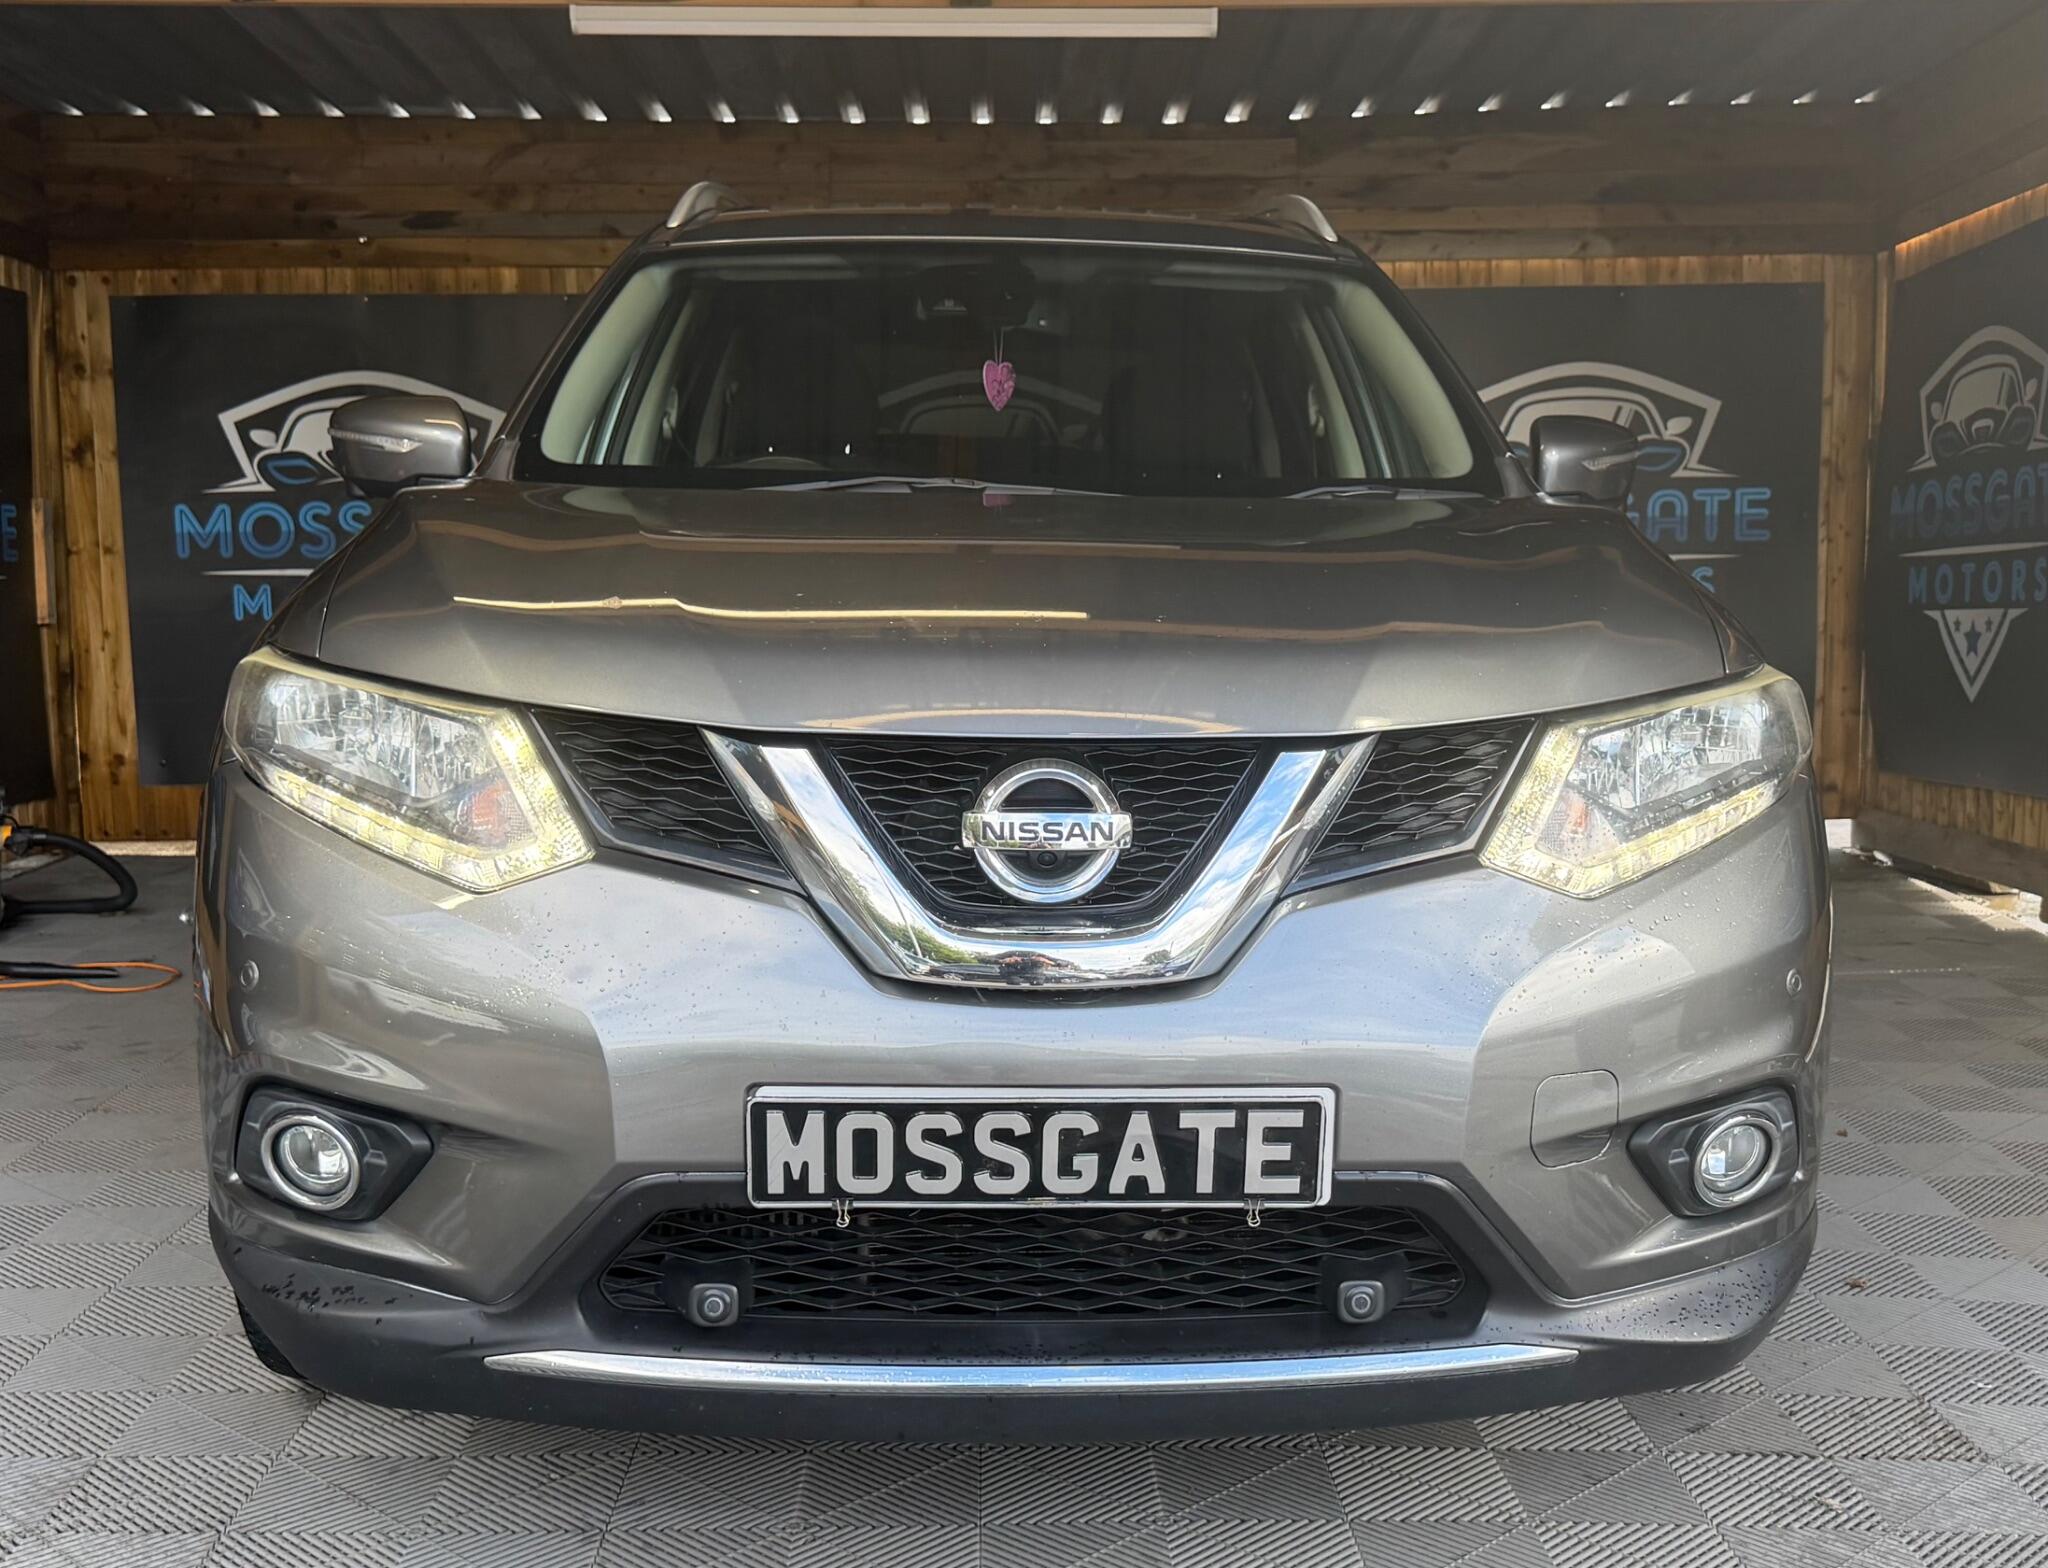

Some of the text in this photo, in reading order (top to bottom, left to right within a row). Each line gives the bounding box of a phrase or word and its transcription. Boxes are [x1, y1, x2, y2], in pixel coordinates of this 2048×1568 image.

[1627, 487, 1771, 542] ATE
[1908, 556, 2048, 605] MOTORS
[981, 821, 1114, 842] NISSAN
[766, 1109, 1304, 1195] MOSSGATE
